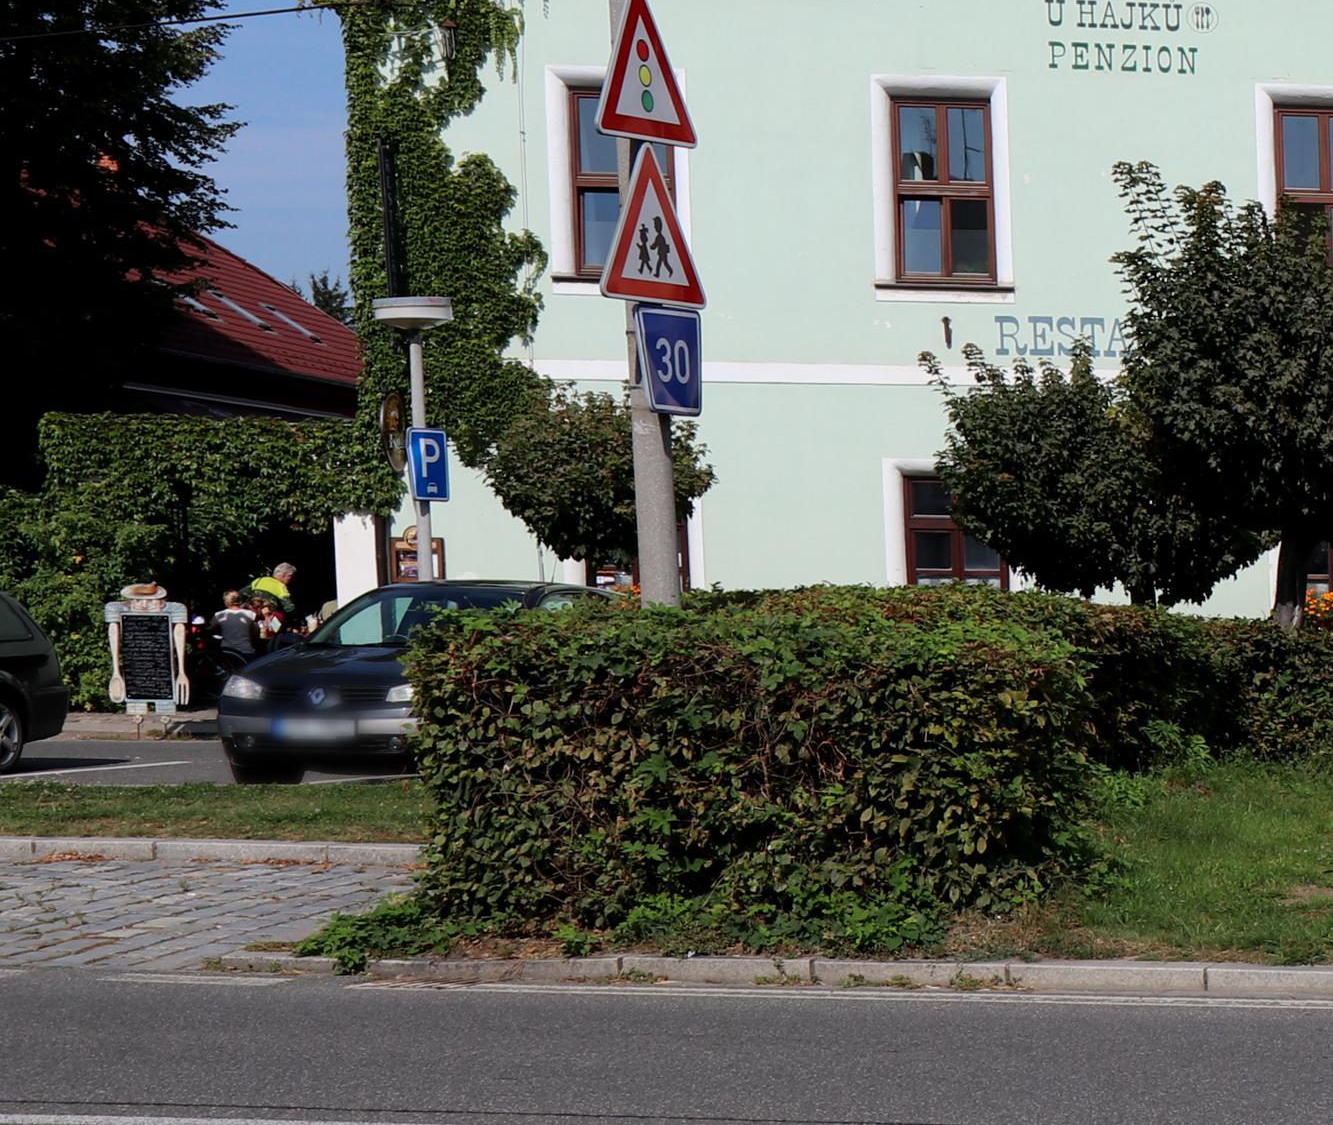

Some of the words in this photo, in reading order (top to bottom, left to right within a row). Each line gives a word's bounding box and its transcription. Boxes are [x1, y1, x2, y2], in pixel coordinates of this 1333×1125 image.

[1047, 41, 1199, 74] PENZION
[994, 315, 1132, 358] RESTA
[655, 337, 691, 384] 30
[418, 437, 440, 478] P
